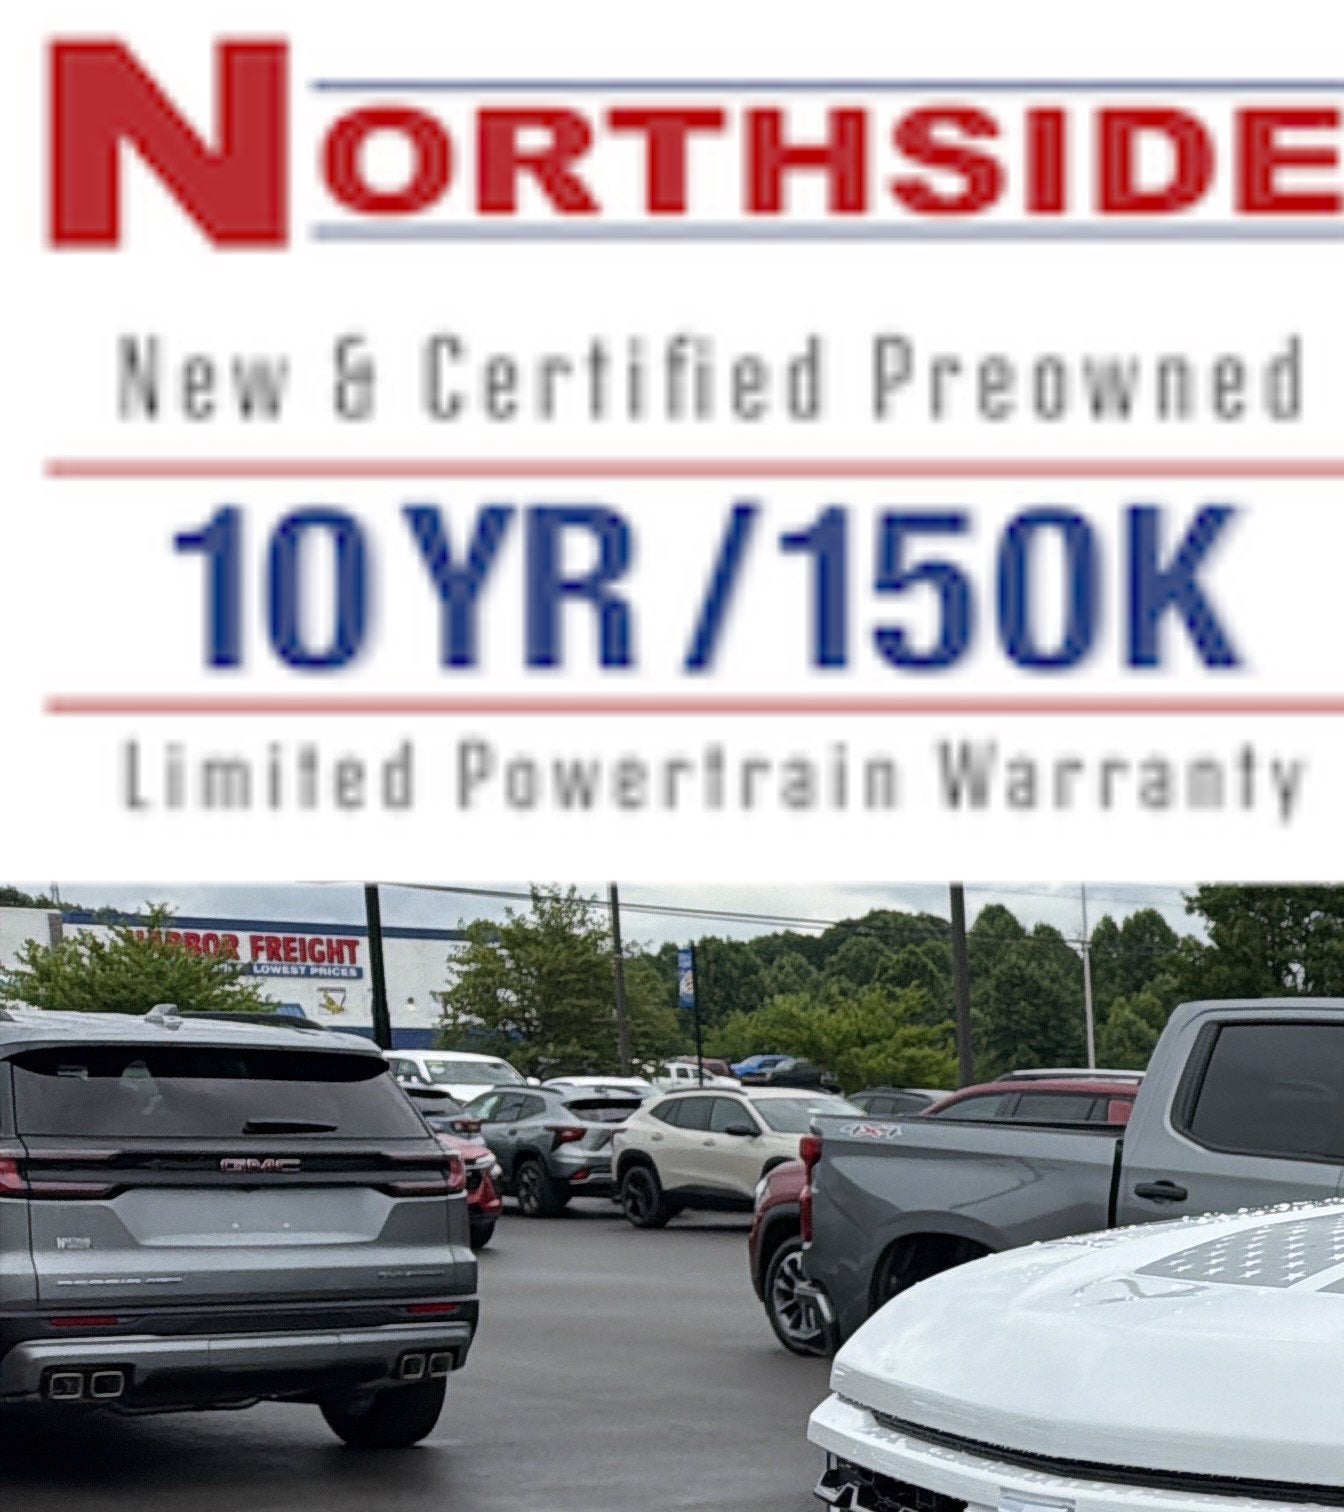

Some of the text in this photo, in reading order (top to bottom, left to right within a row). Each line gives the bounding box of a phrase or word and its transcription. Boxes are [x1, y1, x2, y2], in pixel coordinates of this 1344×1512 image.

[128, 929, 360, 965] RBOR FREIGHT
[253, 964, 306, 975] LOWEST
[310, 966, 358, 977] PRICES
